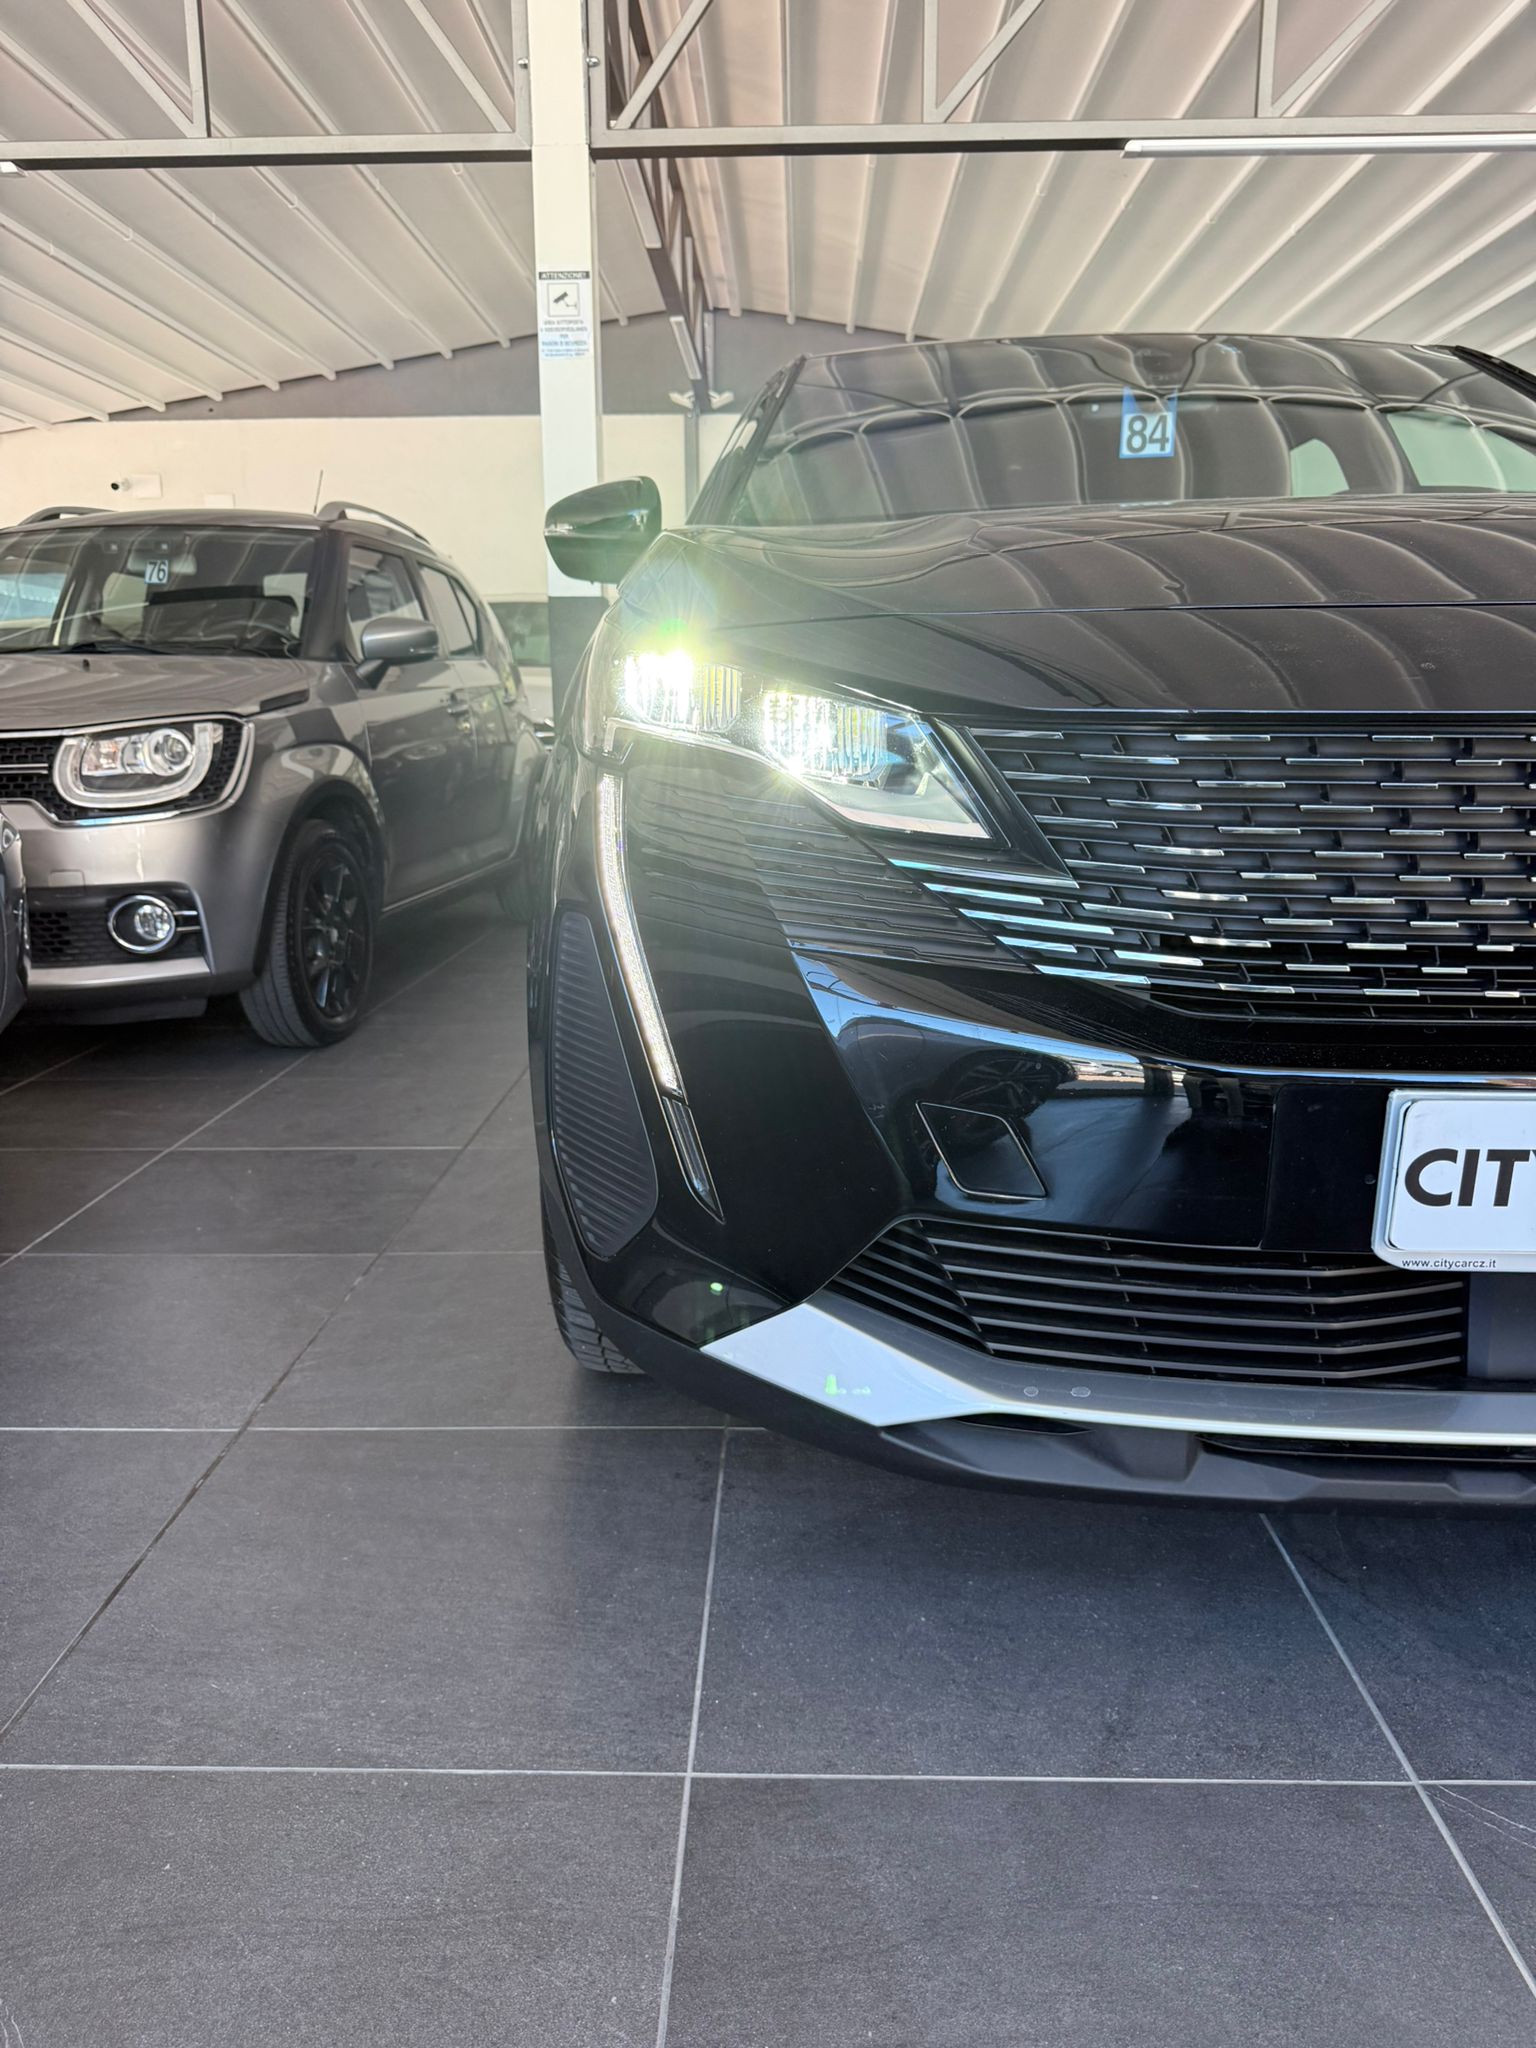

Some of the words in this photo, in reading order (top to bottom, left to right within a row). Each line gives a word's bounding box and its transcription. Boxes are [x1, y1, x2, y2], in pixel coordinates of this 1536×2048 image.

[1126, 414, 1170, 454] 84
[148, 561, 167, 582] 76
[1404, 1148, 1536, 1207] CIT
[1402, 1258, 1496, 1270] www.citycarcz.it
